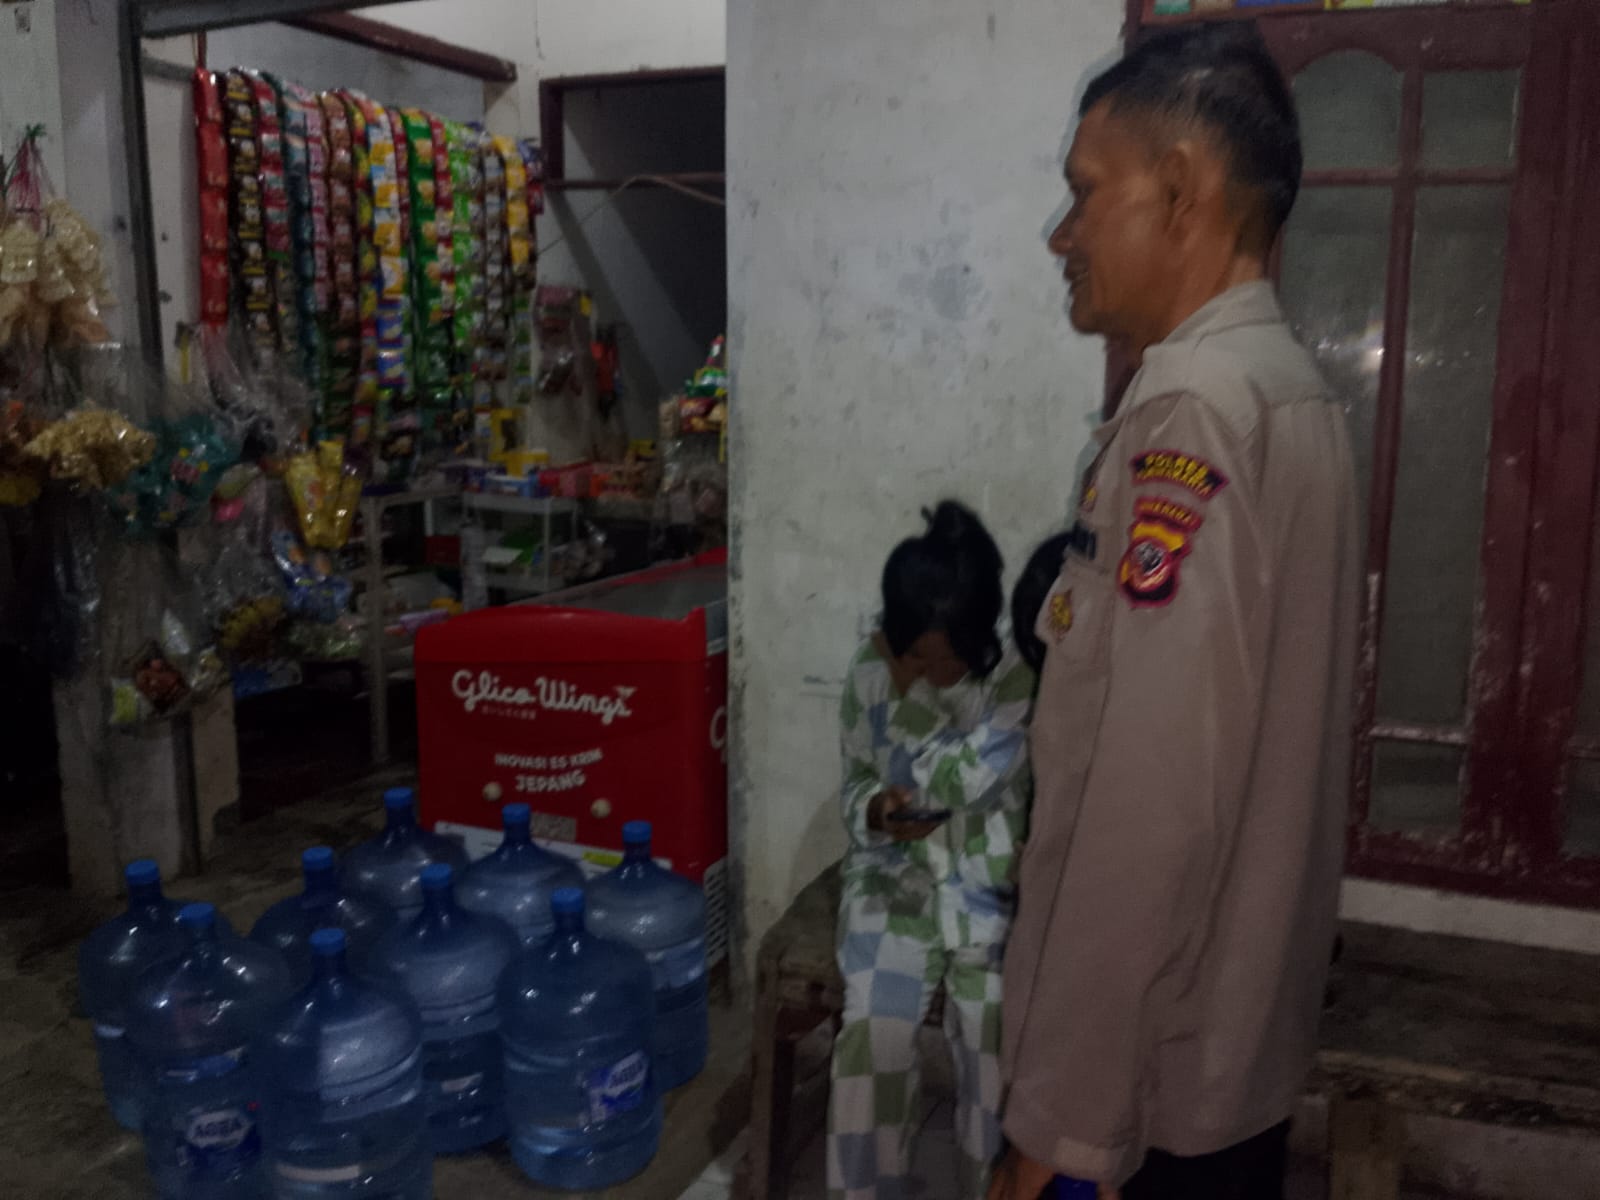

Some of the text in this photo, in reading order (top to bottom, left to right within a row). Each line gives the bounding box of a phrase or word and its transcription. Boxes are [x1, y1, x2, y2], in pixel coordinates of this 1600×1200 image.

[451, 669, 634, 726] Glico Wings
[494, 747, 604, 770] INOVASI ES KRIM
[514, 770, 586, 793] JEPANG
